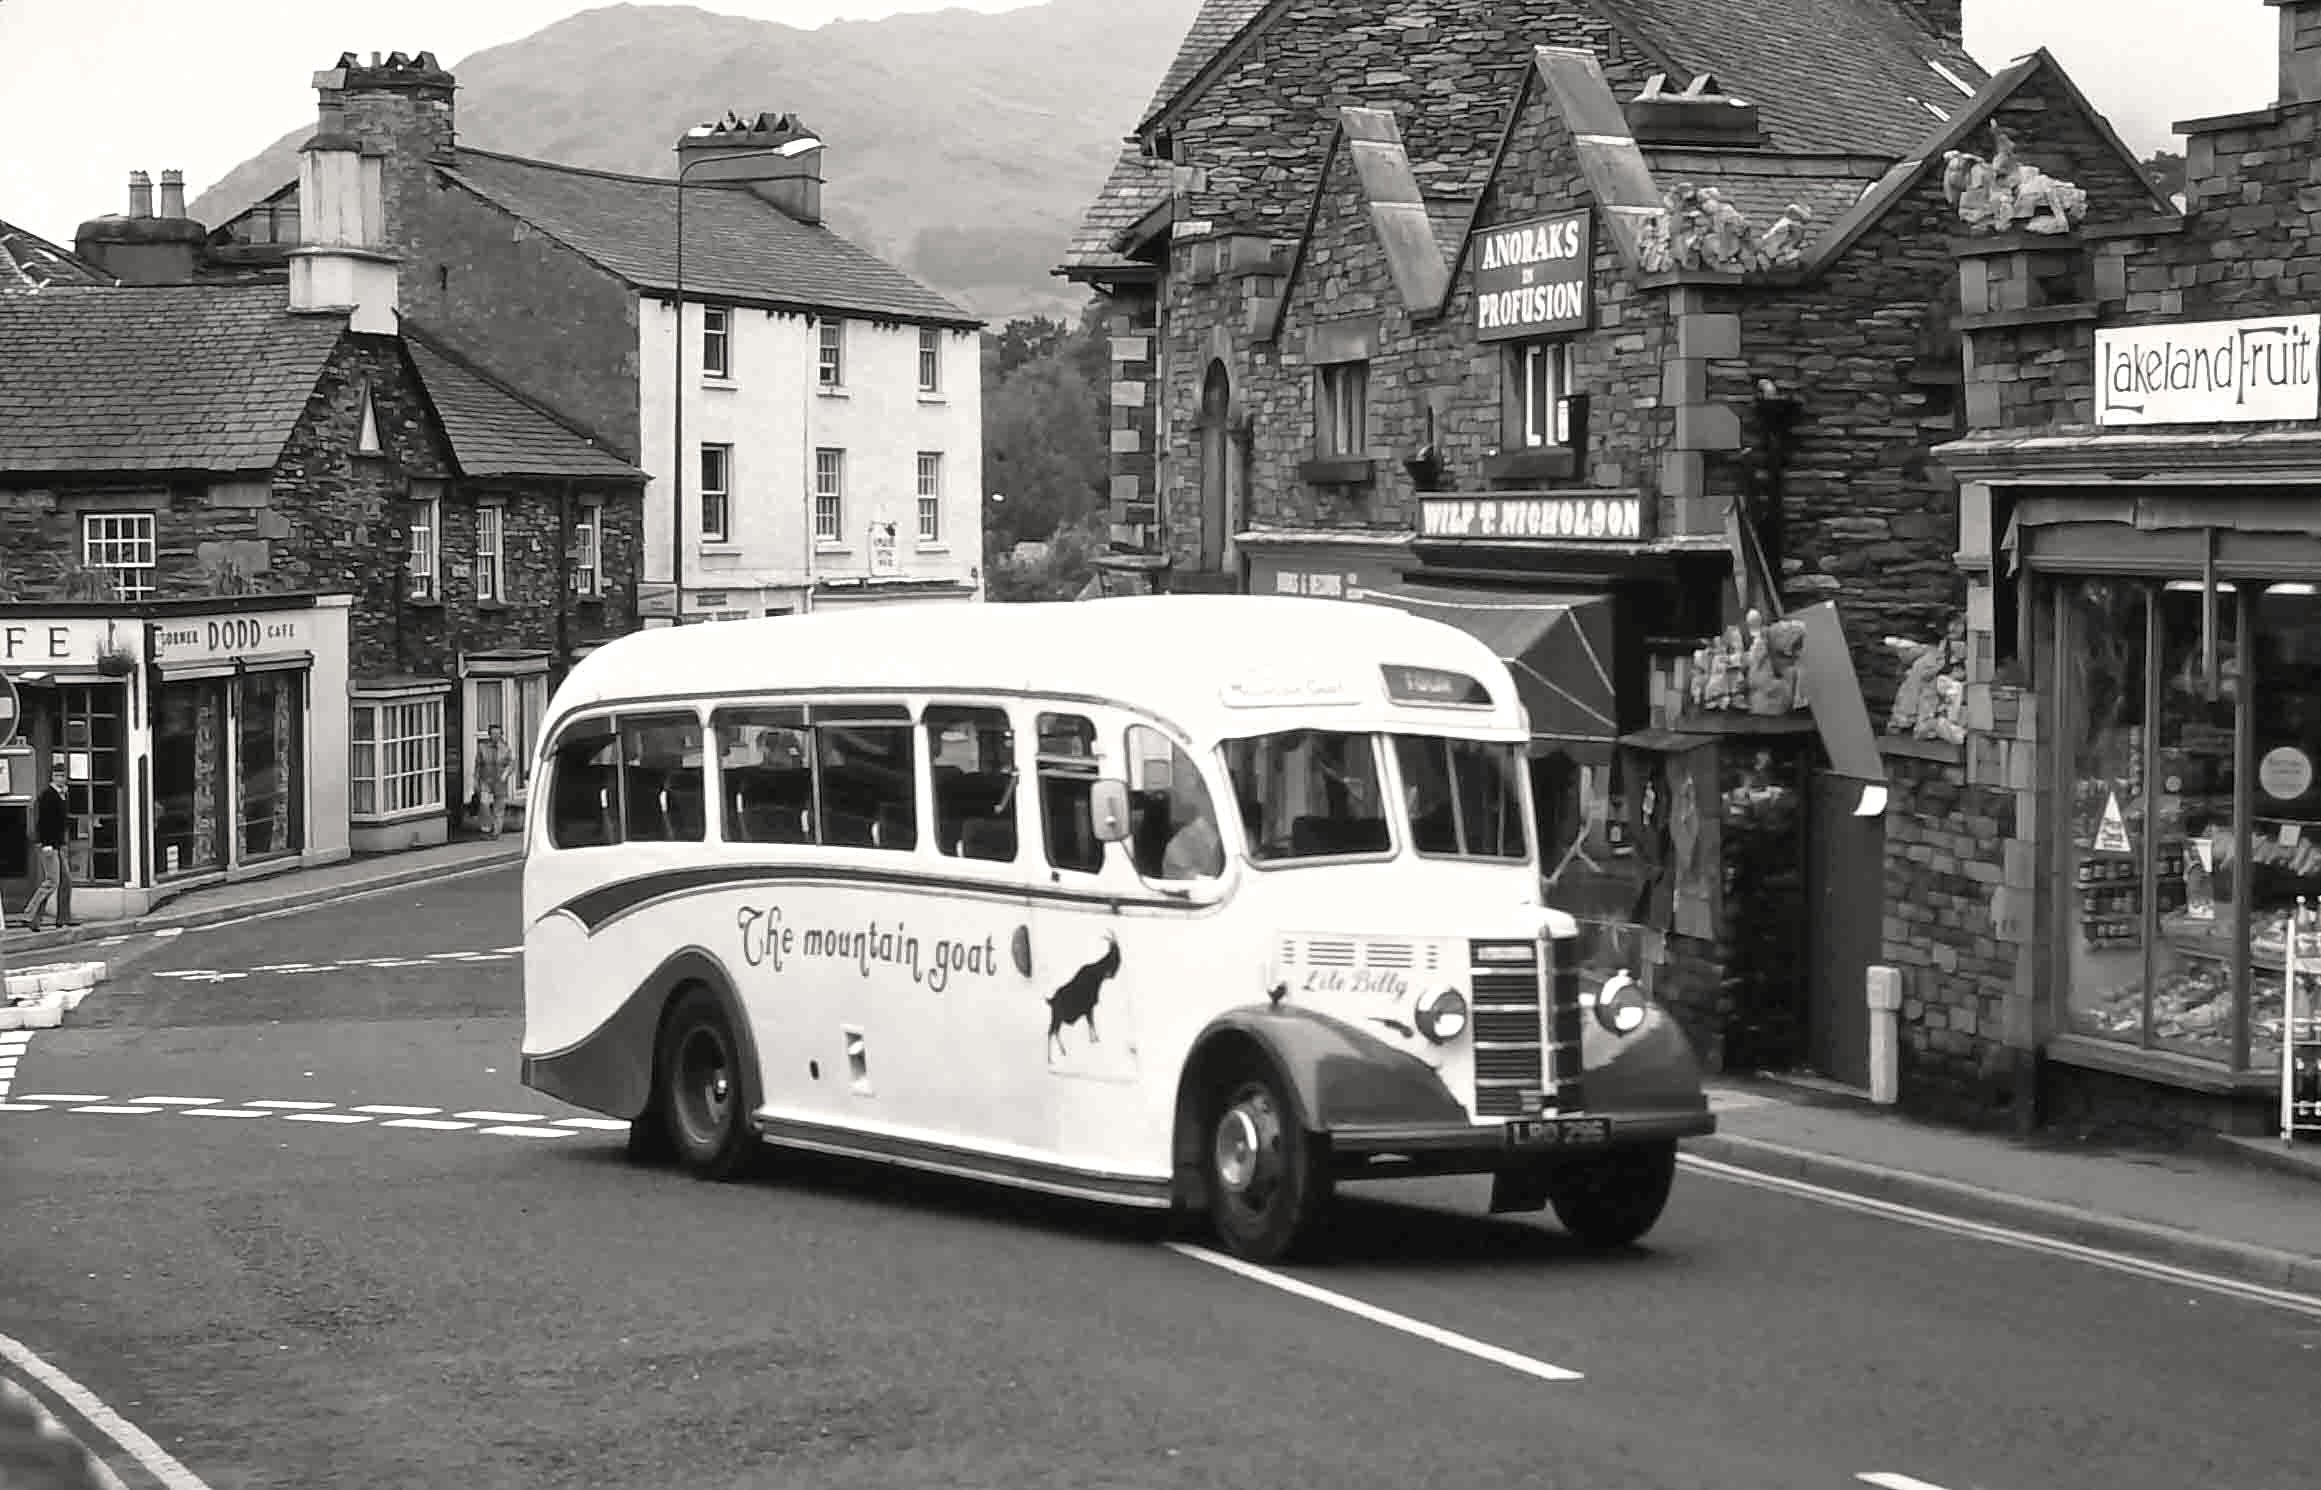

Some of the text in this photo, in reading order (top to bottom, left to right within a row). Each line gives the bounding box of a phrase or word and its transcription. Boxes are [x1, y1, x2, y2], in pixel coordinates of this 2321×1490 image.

[1481, 220, 1579, 270] ANORAKS
[1478, 280, 1584, 329] PROFUSION
[2235, 324, 2312, 405] Fruit
[1424, 501, 1475, 535] WILF
[1500, 499, 1640, 538] NICHOLSON
[207, 619, 262, 651] DODD
[267, 623, 296, 639] CAFE
[736, 905, 998, 993] The mountain goat
